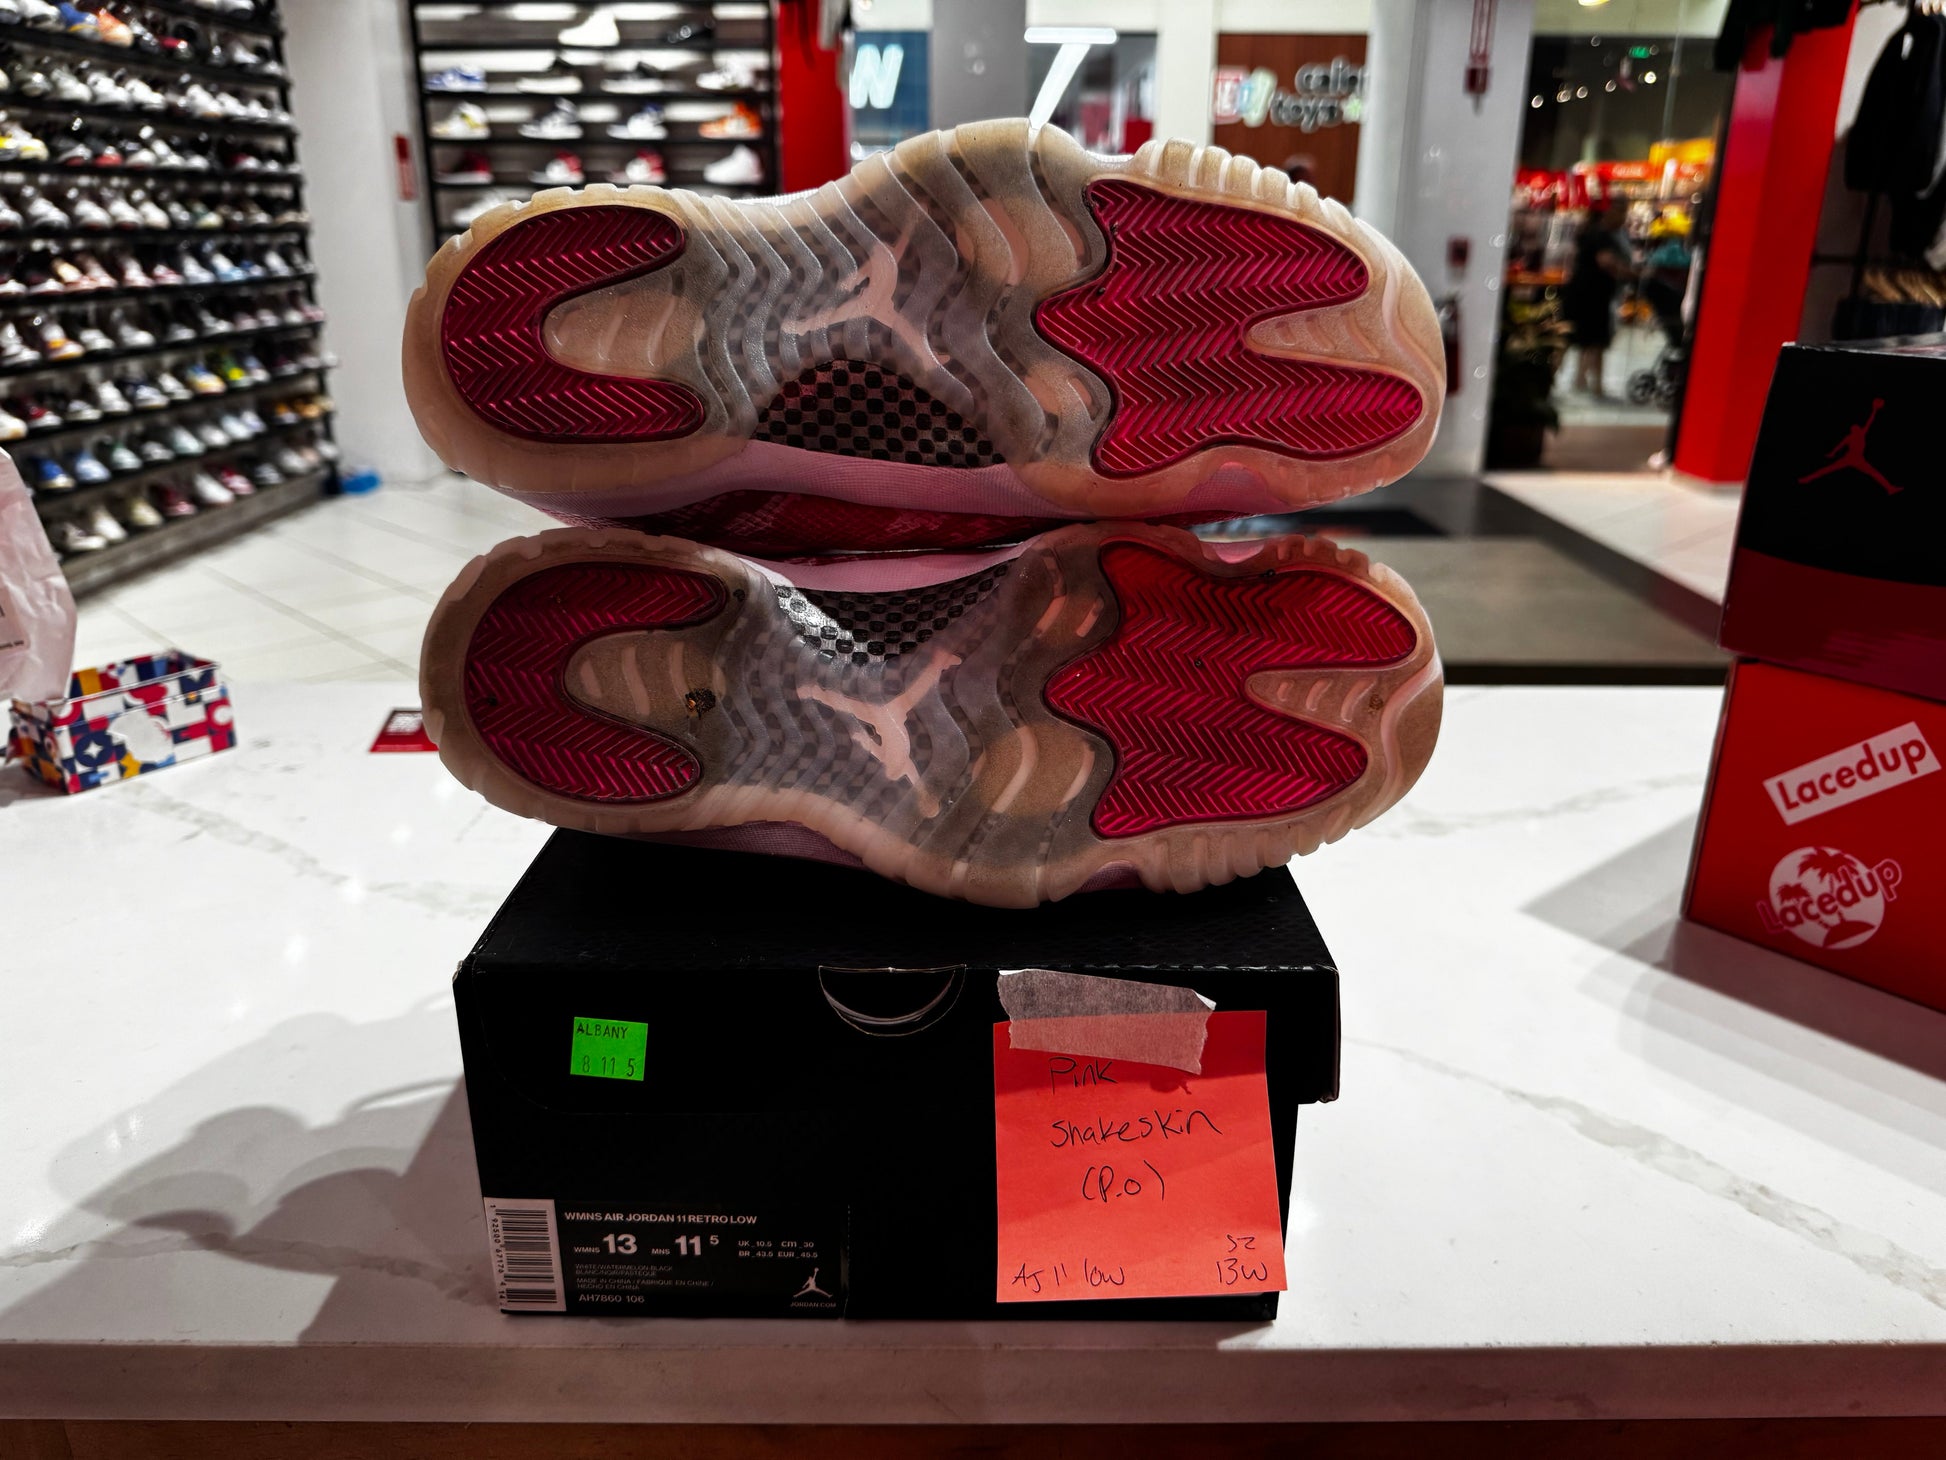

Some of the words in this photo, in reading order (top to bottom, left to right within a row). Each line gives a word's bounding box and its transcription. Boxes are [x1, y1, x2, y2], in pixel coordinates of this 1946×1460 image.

[1776, 738, 1927, 812] Lacedup
[1755, 858, 1903, 934] Lacedup
[576, 1022, 629, 1040] ALBANY
[582, 1054, 591, 1074] 8
[601, 1055, 616, 1075] 11
[626, 1057, 636, 1077] 5
[1048, 1056, 1118, 1096] Pink
[564, 1211, 602, 1222] WMNS
[604, 1212, 624, 1222] AIR
[625, 1213, 675, 1223] JORDAN
[676, 1214, 686, 1223] 11
[688, 1214, 728, 1224] RETRO
[729, 1215, 758, 1224] LOW
[573, 1246, 601, 1254] WMNS
[602, 1233, 638, 1255] 13
[651, 1247, 671, 1255] MNS
[673, 1234, 703, 1256] 11
[709, 1235, 721, 1246] 5
[578, 1293, 622, 1303] AH7860
[626, 1294, 646, 1304] 106
